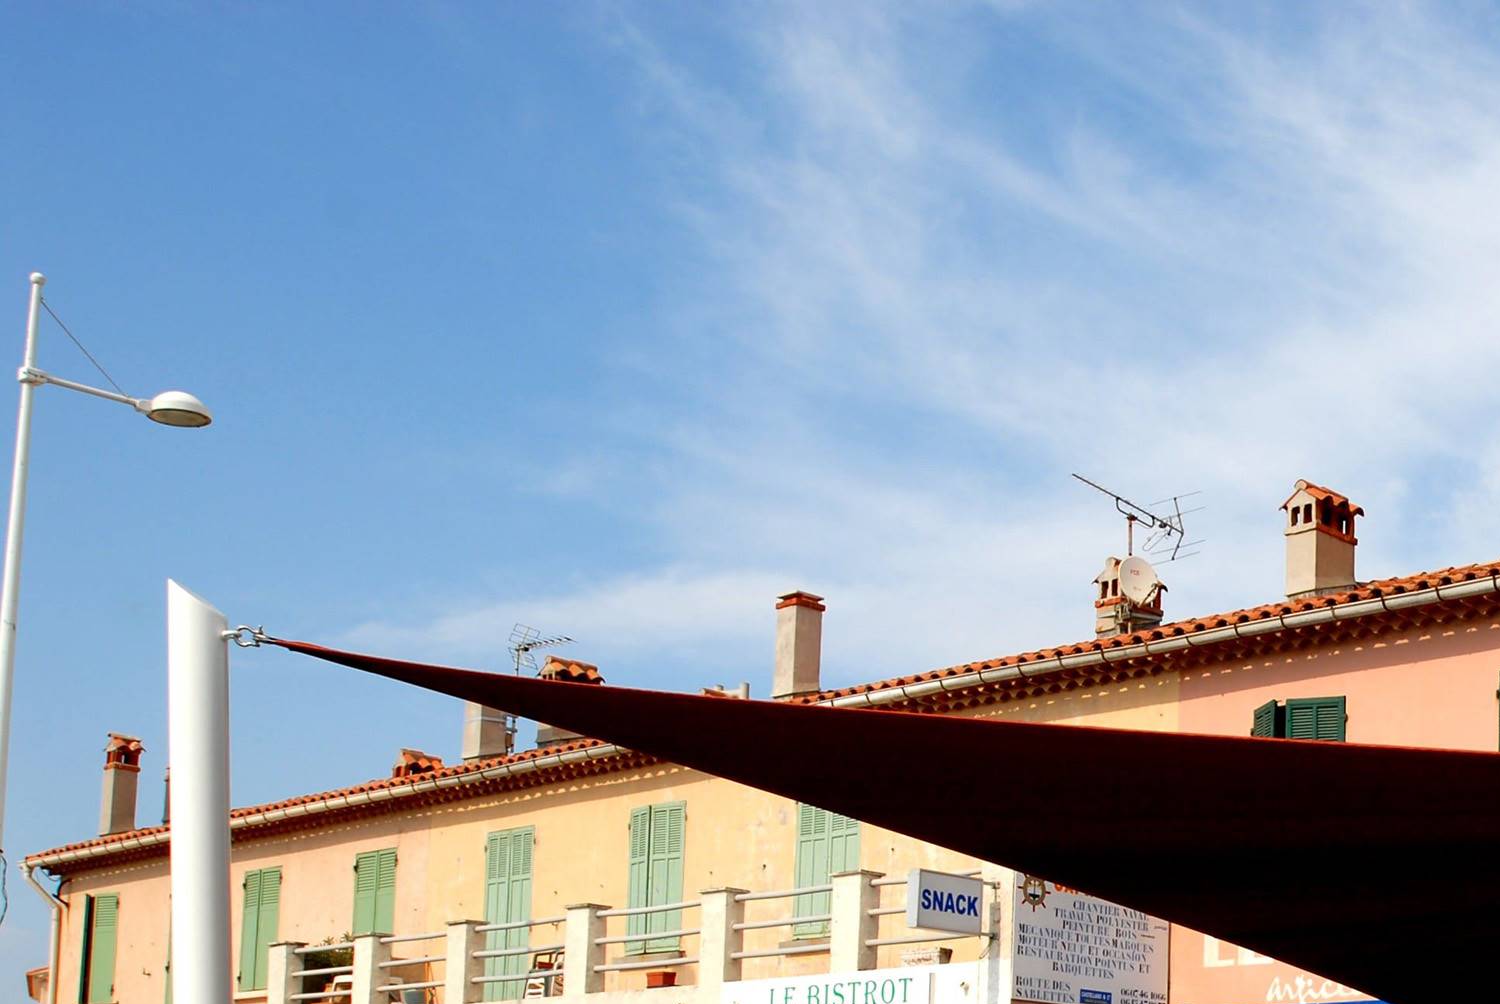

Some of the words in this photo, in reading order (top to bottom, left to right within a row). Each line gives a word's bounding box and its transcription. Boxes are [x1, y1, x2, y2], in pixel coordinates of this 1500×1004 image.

[921, 888, 979, 917] SNACK
[1073, 900, 1120, 917] CHANTIER
[1055, 907, 1093, 923] TRAVAUX
[1096, 914, 1149, 932] POLYESTER
[1062, 920, 1109, 937] PEINTURE
[1115, 928, 1137, 939] BOIS
[1018, 923, 1074, 941] MECANIQUE
[1075, 933, 1110, 948] TOUTES
[1112, 938, 1154, 953] MARQUES
[1018, 934, 1058, 950] MOTEUR
[1088, 945, 1100, 957] ET
[1017, 945, 1092, 965] RESTAURATION
[1139, 963, 1150, 974] ET
[1052, 961, 1114, 979] BARQUETTES
[1015, 975, 1050, 989] ROUTE
[1052, 980, 1071, 991] DES
[1015, 987, 1075, 1003] SABLETTES
